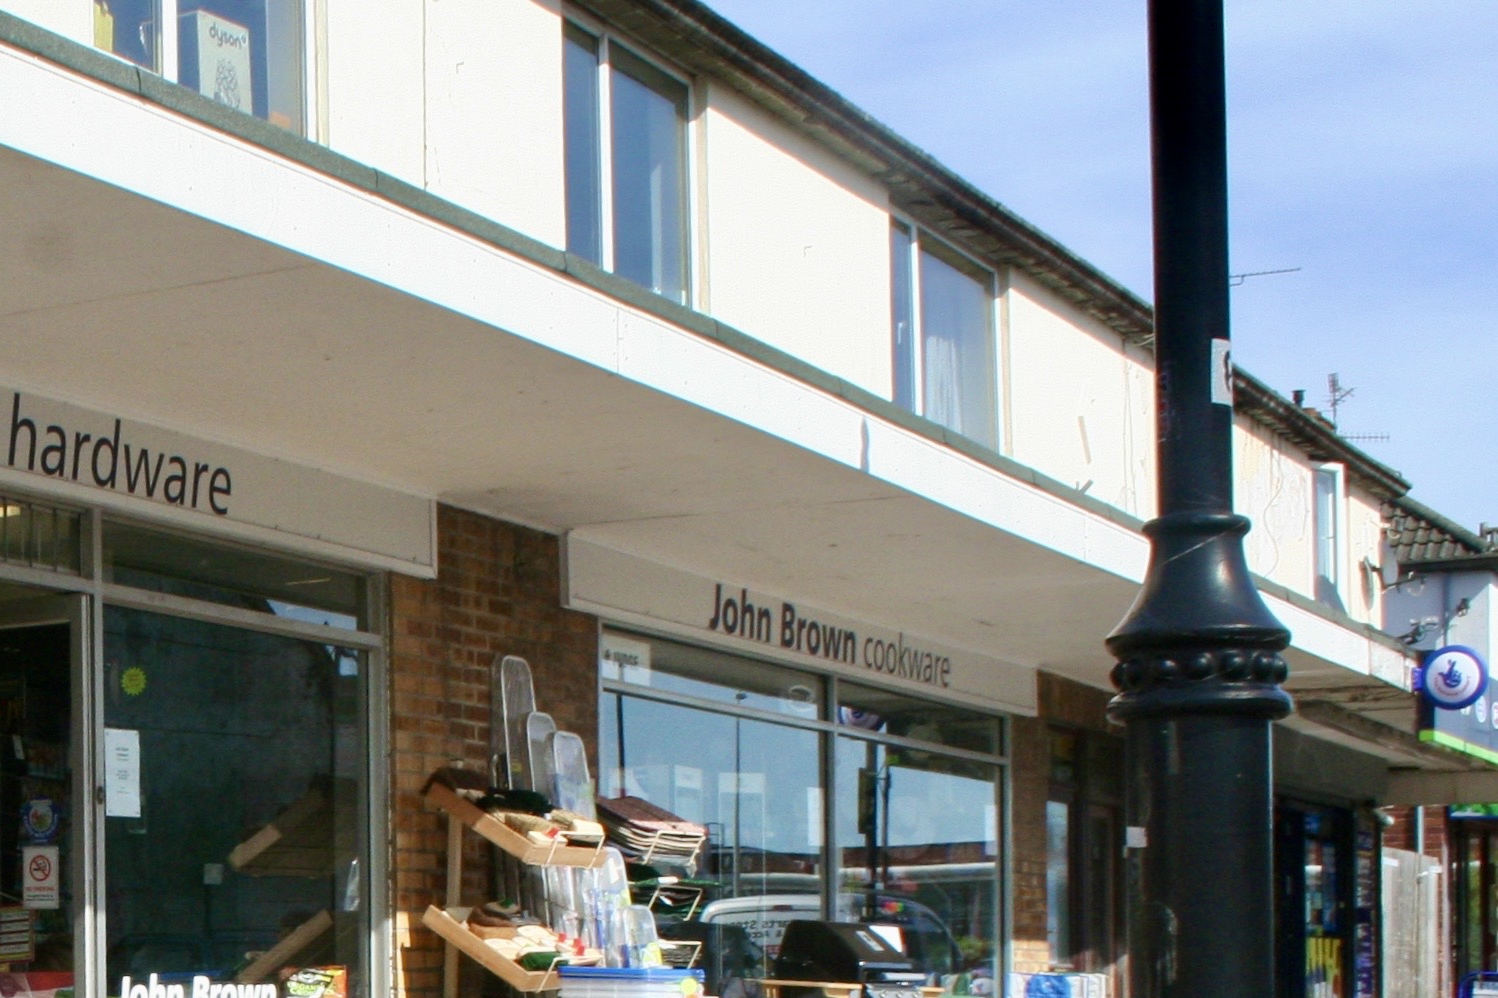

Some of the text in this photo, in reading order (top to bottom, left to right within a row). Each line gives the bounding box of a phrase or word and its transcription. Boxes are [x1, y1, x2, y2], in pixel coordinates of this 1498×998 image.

[208, 22, 242, 50] dyson
[8, 392, 233, 515] hardware
[709, 582, 951, 688] John Brown cookware
